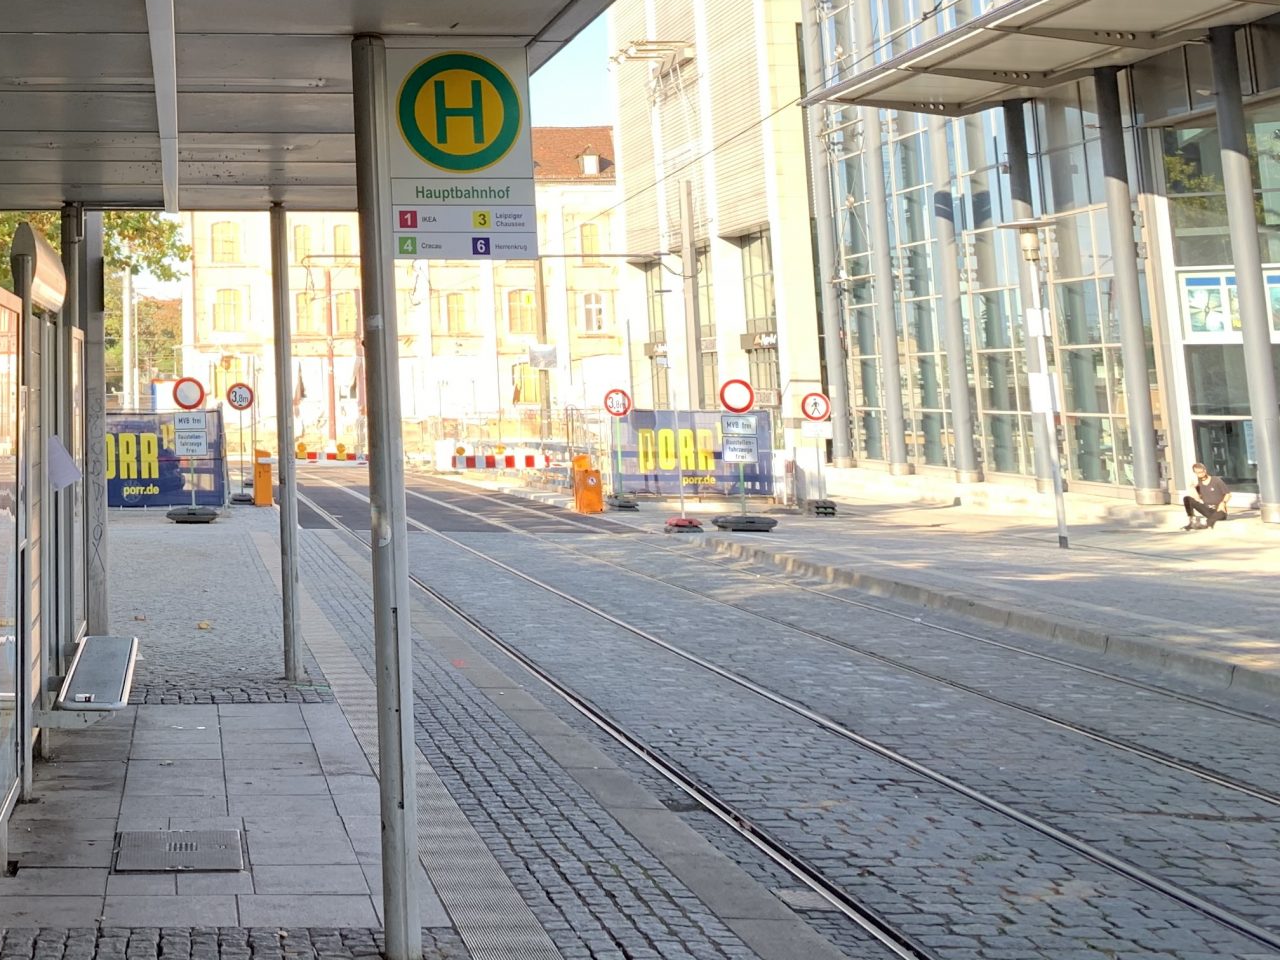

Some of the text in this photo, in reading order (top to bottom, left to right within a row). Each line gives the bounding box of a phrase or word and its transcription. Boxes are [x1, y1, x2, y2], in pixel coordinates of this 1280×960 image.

[433, 79, 485, 144] H
[415, 185, 511, 202] Hauptbahnhof
[403, 213, 412, 226] 1
[478, 212, 523, 226] 3 Leipziger
[403, 239, 442, 252] 4 Cracau
[476, 239, 528, 253] 6 Herrenkrug
[178, 417, 202, 425] MVB frei
[106, 432, 159, 480] ORR
[682, 474, 717, 487] porr.de
[123, 483, 160, 496] porr.de
